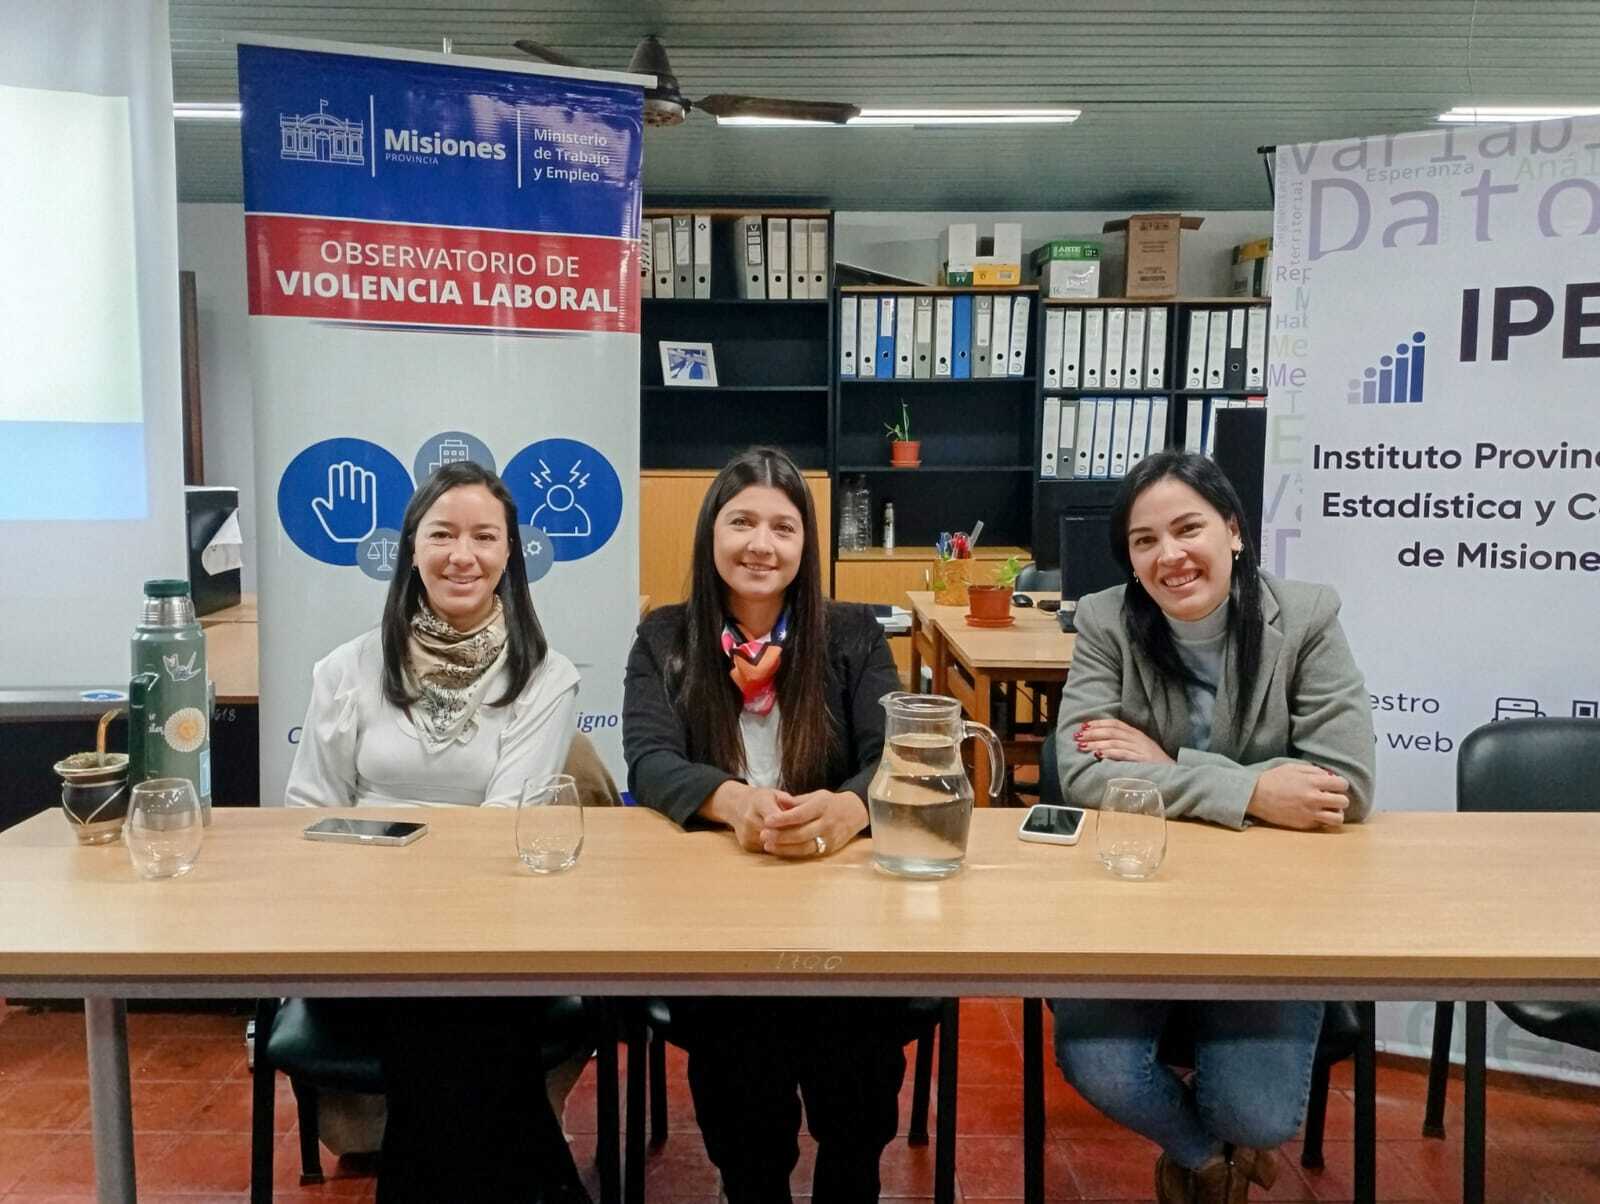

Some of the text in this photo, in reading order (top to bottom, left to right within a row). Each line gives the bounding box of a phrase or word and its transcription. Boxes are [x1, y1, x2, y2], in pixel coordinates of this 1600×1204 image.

[384, 127, 507, 161] Misiones
[533, 126, 609, 147] Ministerio
[385, 153, 439, 164] PROVINCIA
[533, 147, 611, 169] de Trabajo
[533, 166, 600, 183] y Empleo
[1365, 161, 1475, 184] Esperanza
[320, 240, 580, 278] OBSERVATORIO DE
[275, 269, 619, 313] VIOLENCIA LABORAL
[1313, 443, 1463, 470] Instituto
[1322, 491, 1522, 520] Estadística
[1534, 499, 1555, 527] y
[1397, 541, 1445, 568] de
[1387, 731, 1454, 753] web
